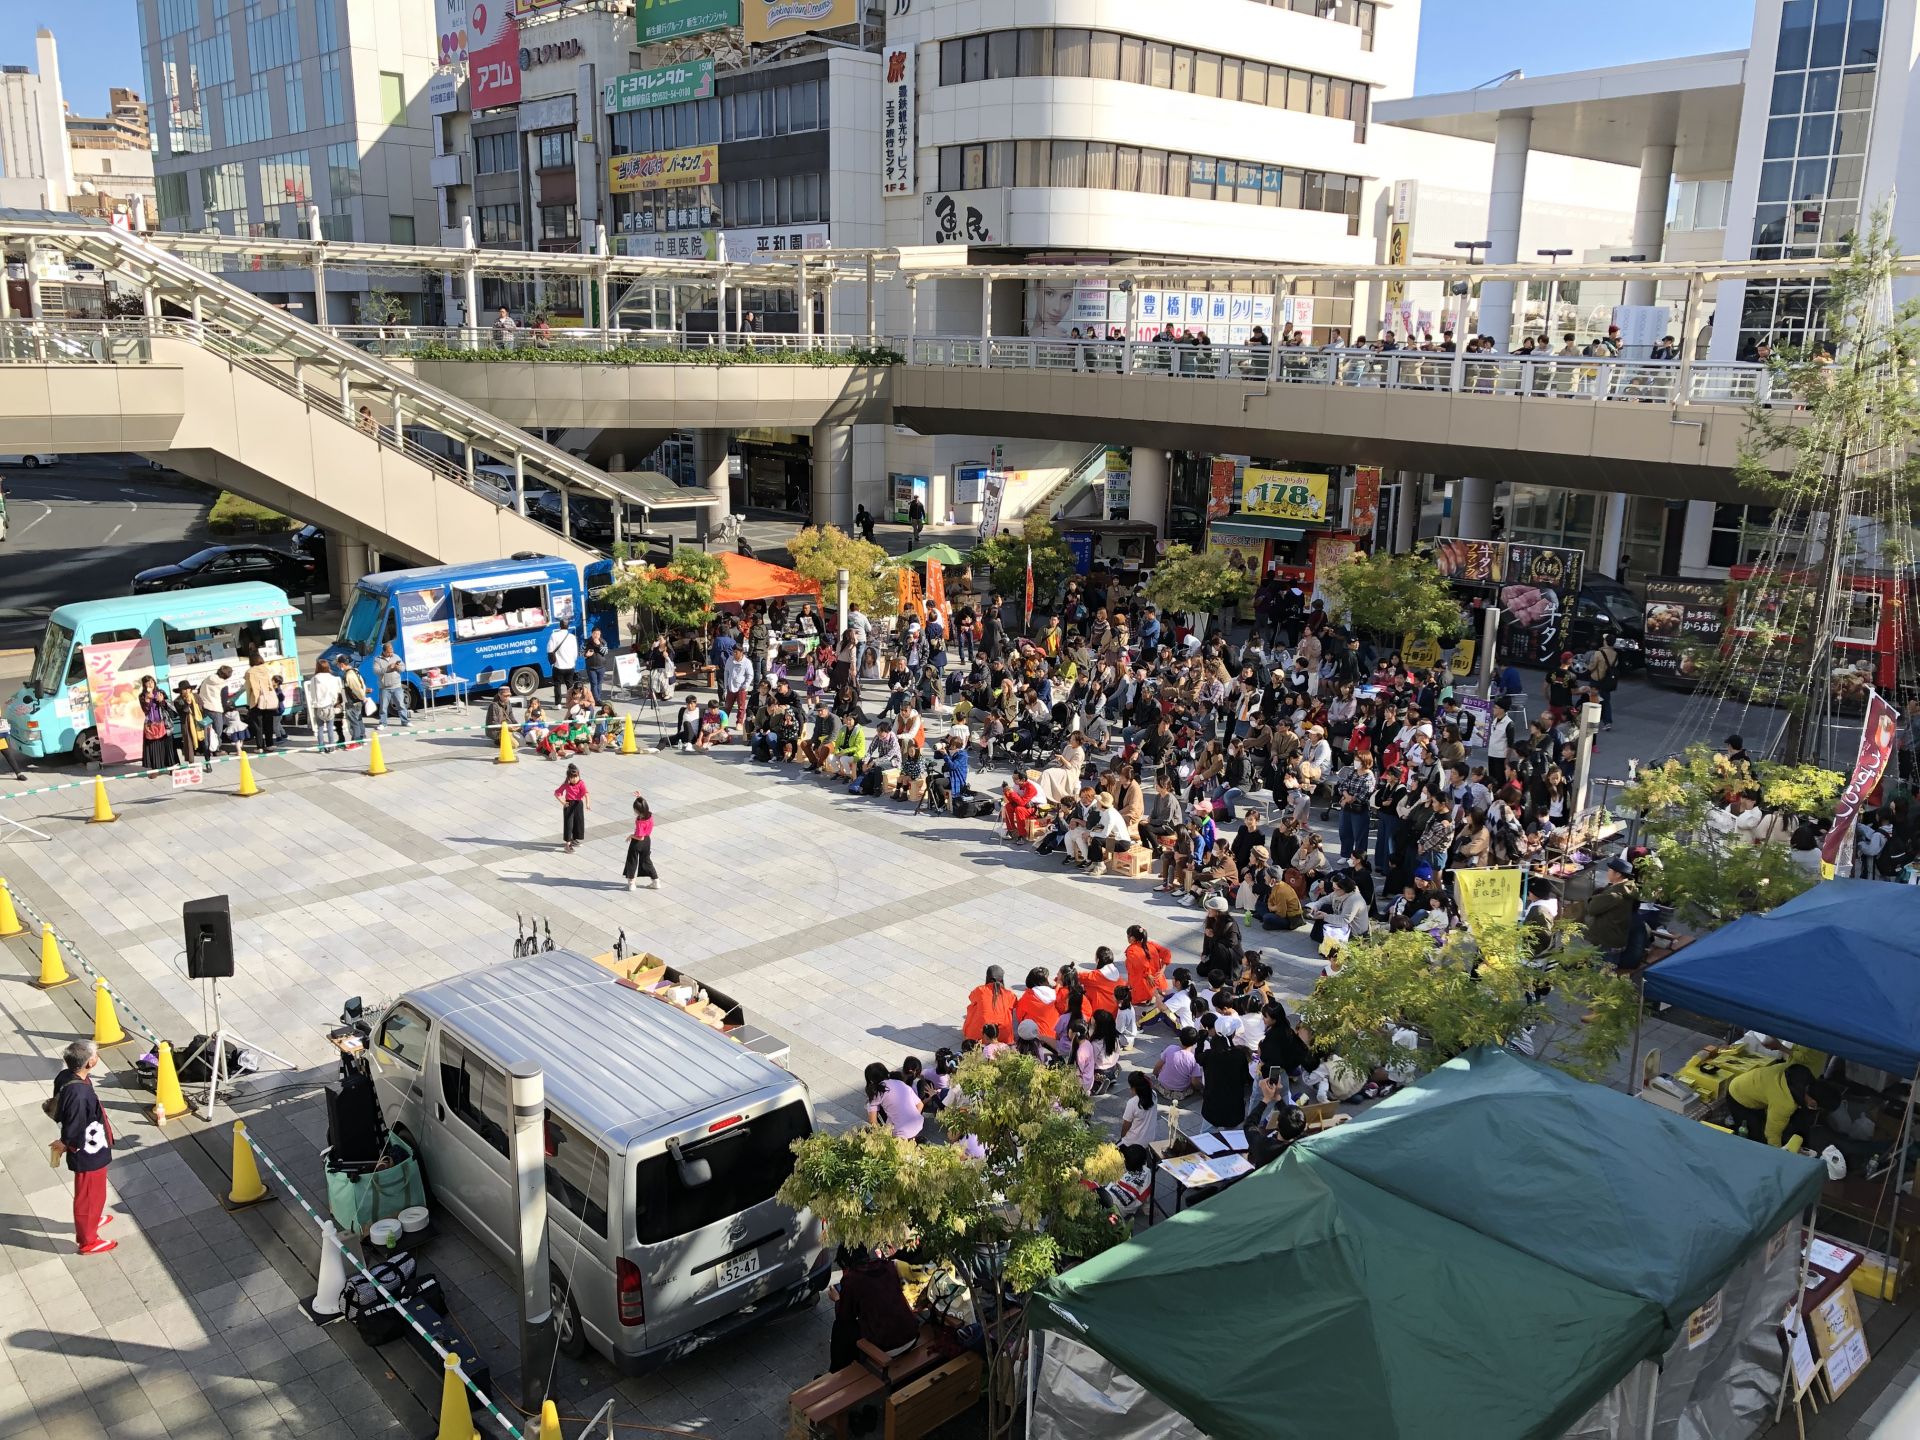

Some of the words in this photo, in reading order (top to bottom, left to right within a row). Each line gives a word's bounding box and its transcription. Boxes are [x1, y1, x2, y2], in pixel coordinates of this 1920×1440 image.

[477, 61, 513, 92] アコム
[697, 61, 712, 73] 150M
[887, 51, 907, 83] 旅
[620, 70, 693, 94] トヨタレンタカー
[886, 101, 895, 180] エモア旅行センター
[666, 154, 701, 172] パーキング
[885, 183, 897, 192] 1F
[926, 196, 933, 206] 2F
[935, 194, 989, 244] 魚民
[655, 236, 703, 257] 中里医院
[757, 234, 803, 250] 平和園
[1258, 483, 1310, 505] 178
[1466, 543, 1478, 577] フランク
[1477, 545, 1493, 578] 牛タン
[1539, 603, 1562, 662] 牛タン
[1683, 621, 1721, 632] からあげ
[475, 643, 509, 653] SANDWICH
[509, 638, 537, 648] MOMENT
[91, 653, 119, 737] ジェラート
[726, 1258, 757, 1282] 52-47
